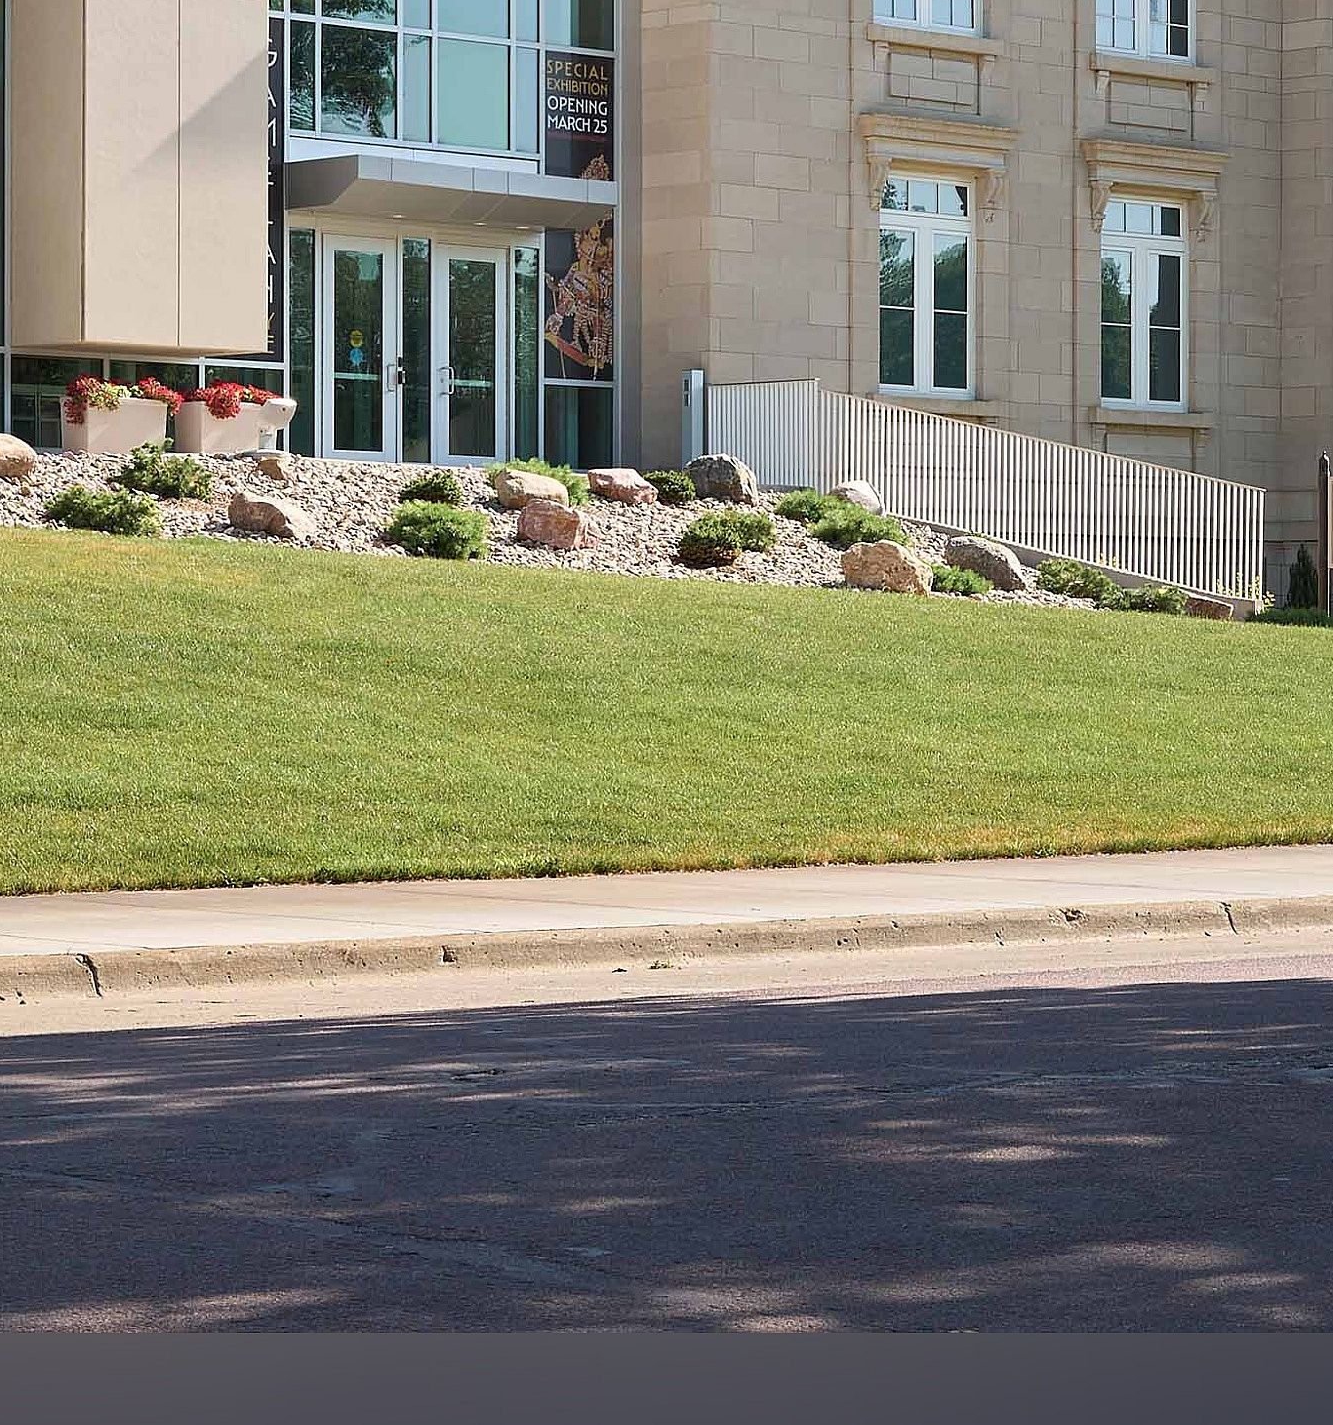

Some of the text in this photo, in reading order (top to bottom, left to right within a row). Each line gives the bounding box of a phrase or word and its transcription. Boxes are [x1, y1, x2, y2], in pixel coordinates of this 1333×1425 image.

[547, 60, 608, 80] SPECIAL
[547, 77, 608, 96] EXHIBITION
[547, 95, 608, 116] OPENING
[548, 115, 608, 134] MARCH 25
